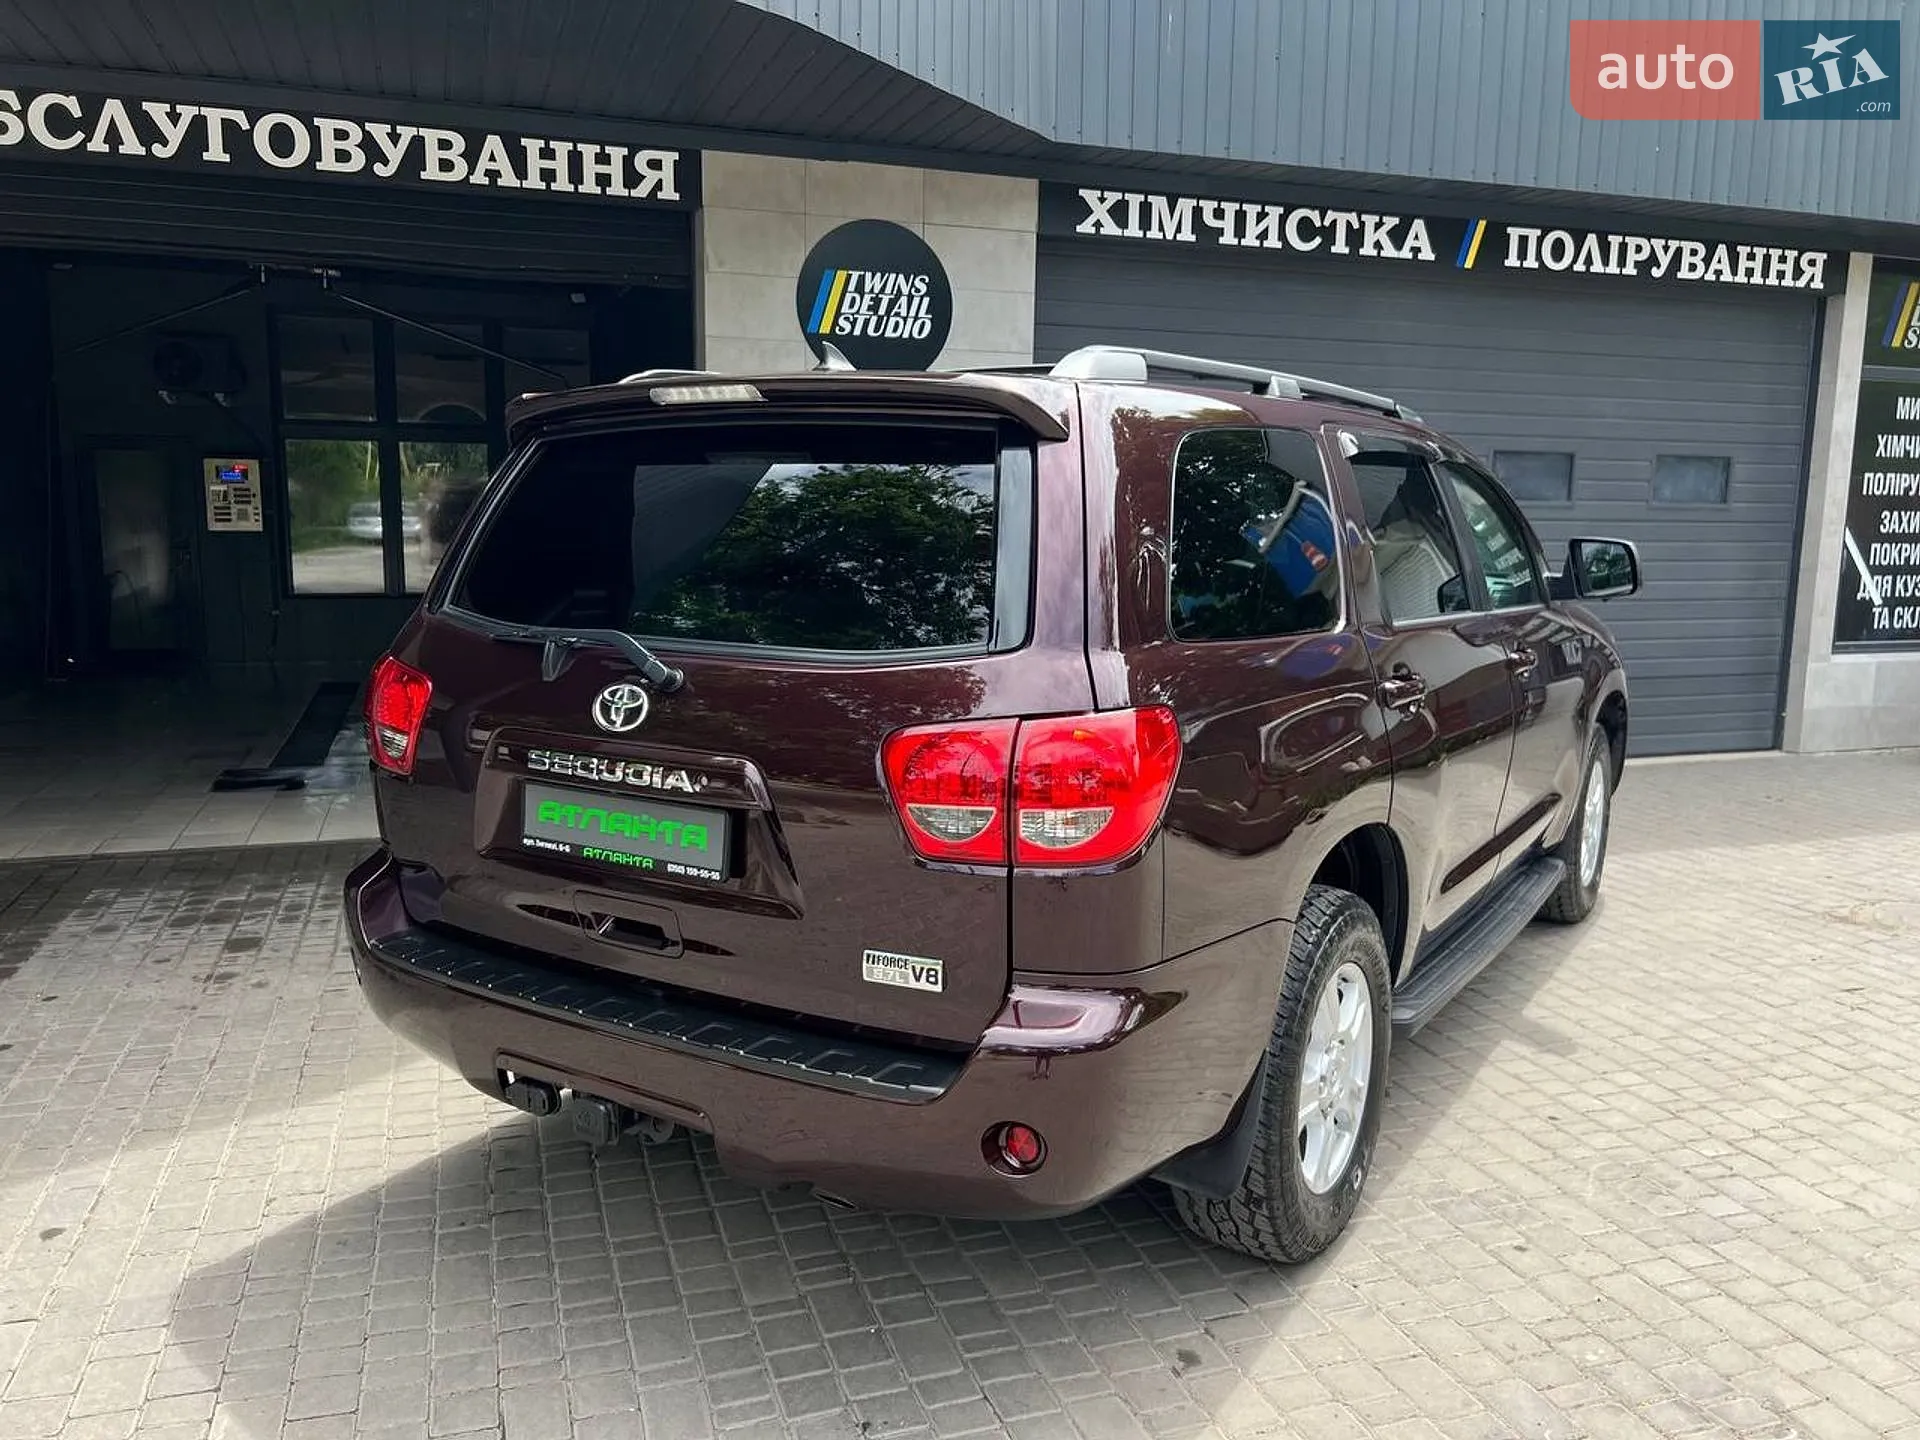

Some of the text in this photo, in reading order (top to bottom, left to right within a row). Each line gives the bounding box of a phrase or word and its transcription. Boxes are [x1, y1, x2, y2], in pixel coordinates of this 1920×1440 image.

[1075, 188, 1436, 262] ХІМЧИСТКА
[1504, 226, 1829, 290] ПОЛІРУВАННЯ
[847, 270, 930, 297] TWINS
[840, 292, 933, 319] DETAIL
[835, 314, 932, 340] STUDIO
[1862, 472, 1920, 497] ПОЛІРУ
[1872, 606, 1890, 630] ТА
[527, 749, 695, 793] SEQUOIA
[911, 964, 939, 986] V8
